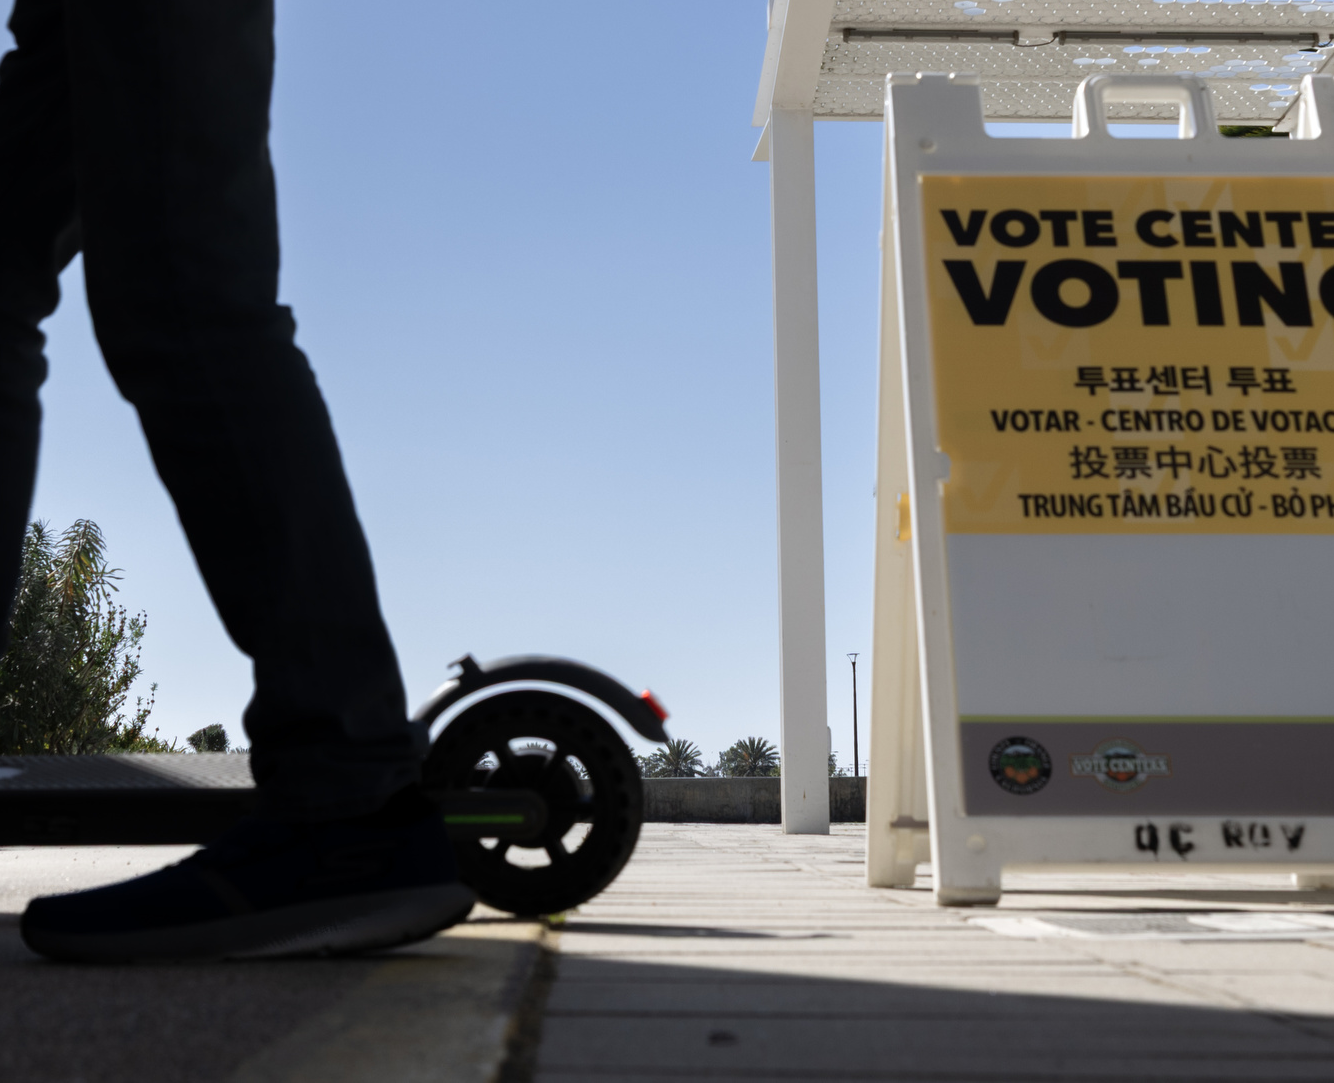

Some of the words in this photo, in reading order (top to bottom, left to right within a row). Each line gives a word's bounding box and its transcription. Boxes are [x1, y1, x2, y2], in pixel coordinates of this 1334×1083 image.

[939, 209, 1117, 248] VOTE
[1074, 365, 1213, 396] 투표센터
[1226, 366, 1297, 396] 투표
[990, 409, 1081, 432] VOTAR
[1101, 409, 1205, 432] CENTRO
[1211, 410, 1247, 432] DE
[1069, 445, 1322, 480] 投票中心投票
[1018, 493, 1103, 517] TRUNG
[1105, 488, 1161, 517] TÂM
[1271, 486, 1305, 518] BỎ
[1072, 757, 1108, 774] VOTE
